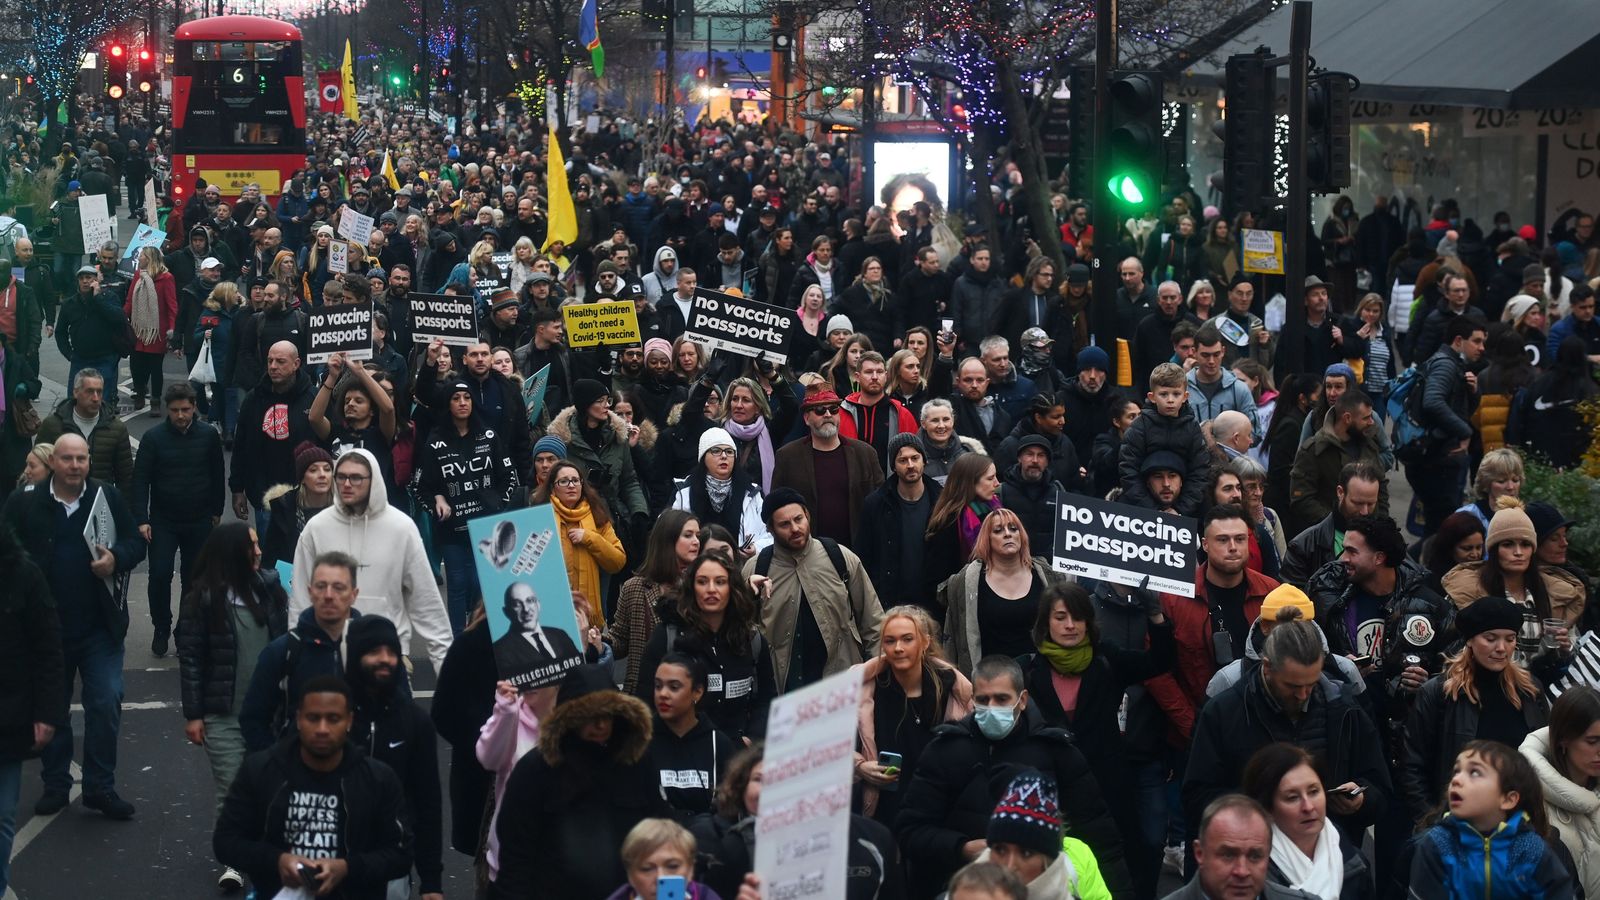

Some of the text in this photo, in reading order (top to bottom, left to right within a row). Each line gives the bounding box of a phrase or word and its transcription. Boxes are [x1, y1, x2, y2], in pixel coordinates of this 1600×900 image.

[233, 68, 244, 83] 6
[475, 278, 499, 287] ccine
[411, 299, 472, 314] no vaccine
[568, 306, 631, 318] Healthy children
[695, 296, 791, 329] no vaccine
[309, 307, 370, 328] no vaccine
[414, 315, 472, 331] passports
[578, 320, 598, 330] don't
[599, 318, 618, 328] need
[311, 325, 368, 348] passports
[573, 329, 635, 343] Covid-19 vaccine
[694, 314, 784, 345] passports
[688, 334, 709, 344] together
[441, 456, 493, 478] RVCA
[1061, 503, 1192, 545] no vaccine
[1064, 529, 1186, 569] passports
[1059, 560, 1089, 573] together
[1120, 575, 1190, 594] www.togerdeclaration.org
